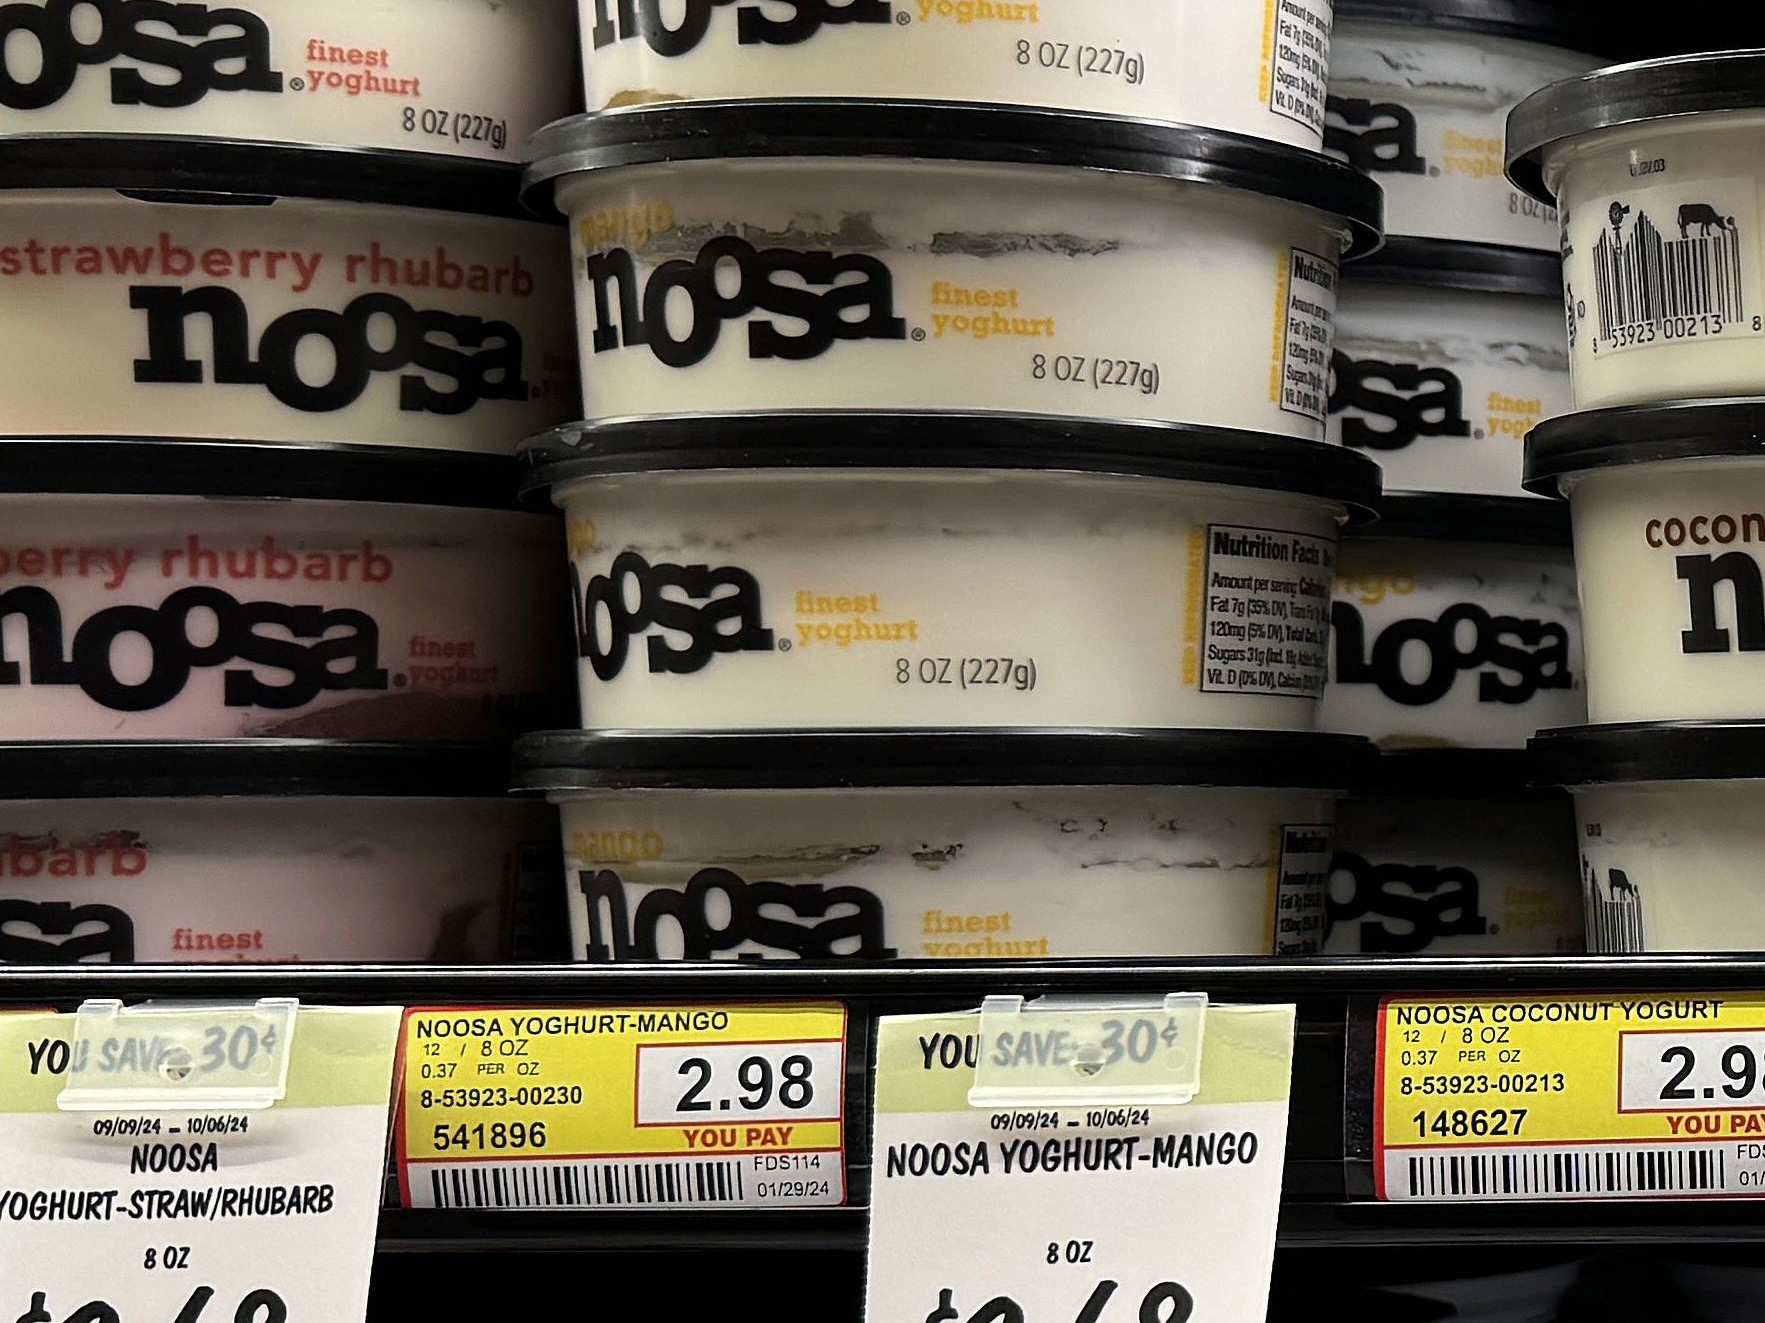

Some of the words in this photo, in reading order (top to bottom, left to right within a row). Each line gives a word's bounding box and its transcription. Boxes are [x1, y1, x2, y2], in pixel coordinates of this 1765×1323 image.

[417, 1018, 503, 1039] NOOSA
[511, 1013, 728, 1037] YOGHURT-MANGO
[421, 1086, 583, 1107] 8-53923-00230
[675, 1055, 814, 1112] 2.98
[433, 1122, 546, 1150] 541896
[131, 1143, 218, 1173] NOOSA
[754, 1155, 820, 1172] FDS114
[887, 1142, 989, 1177] NOOSA
[1001, 1133, 1258, 1173] YOGHURT-MANGO
[757, 1179, 830, 1198] 01/29/24
